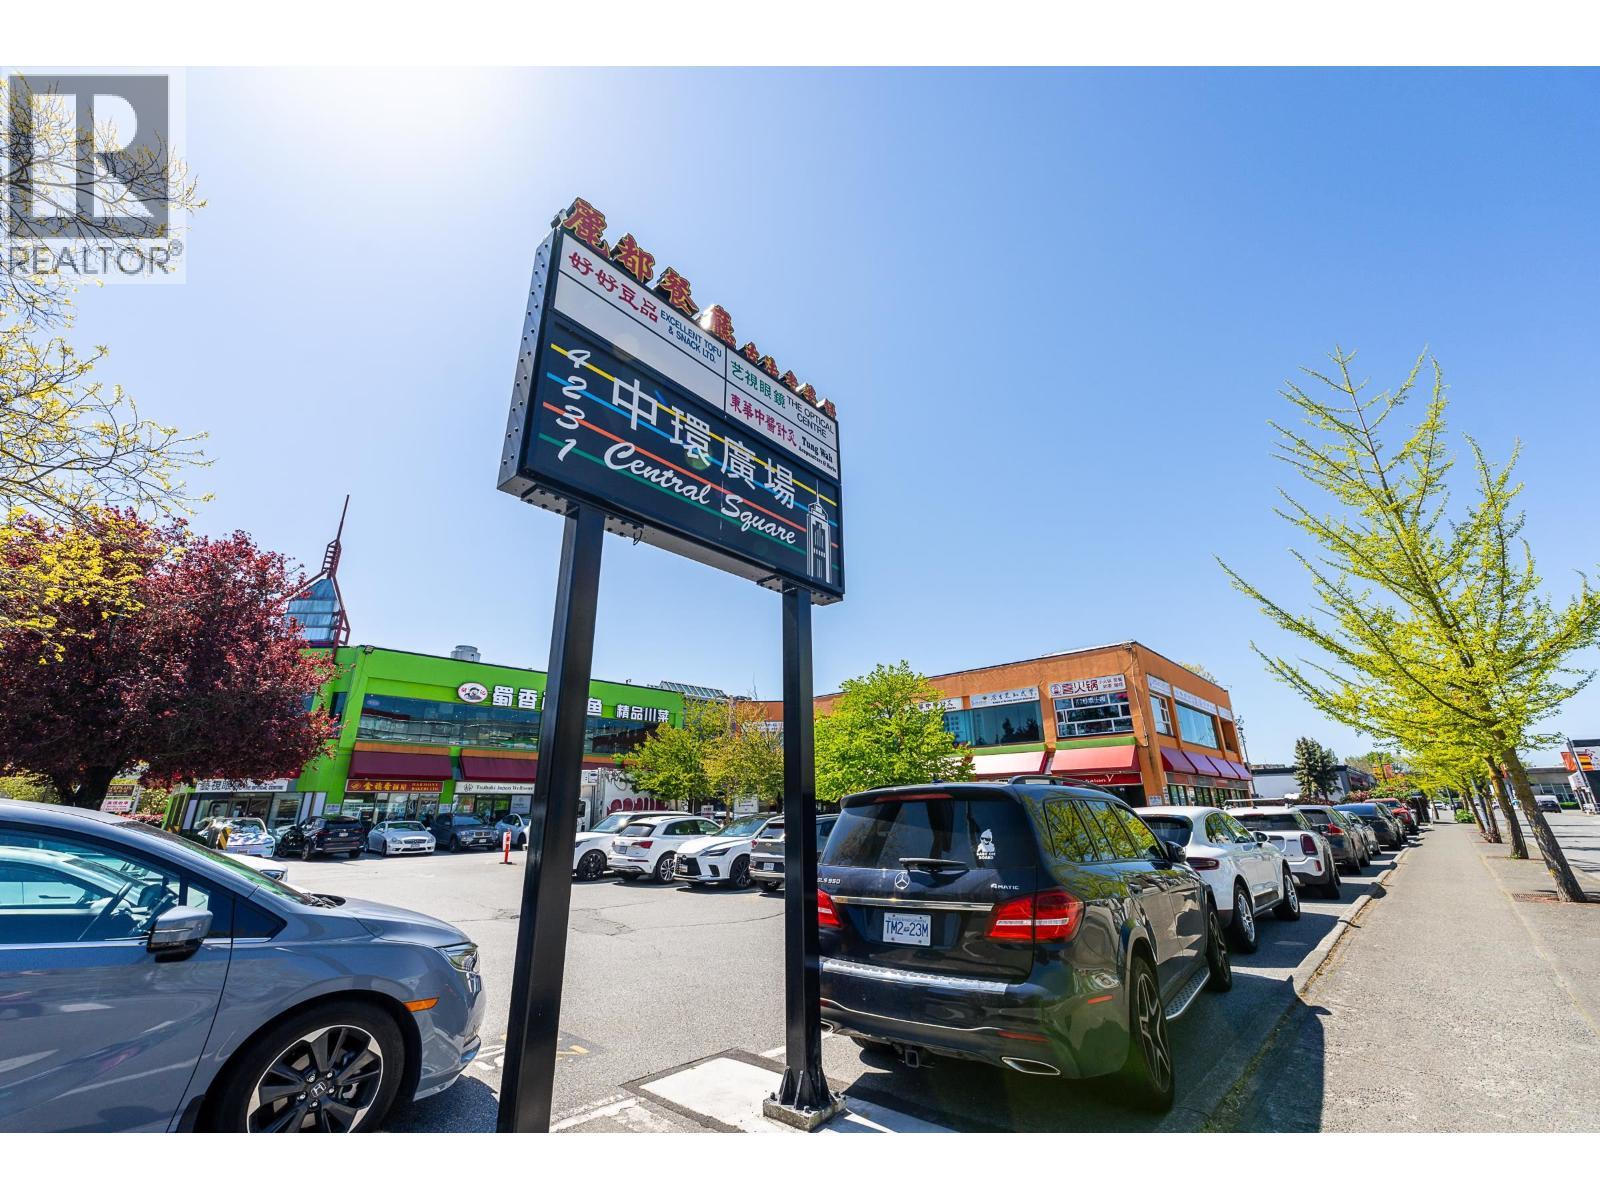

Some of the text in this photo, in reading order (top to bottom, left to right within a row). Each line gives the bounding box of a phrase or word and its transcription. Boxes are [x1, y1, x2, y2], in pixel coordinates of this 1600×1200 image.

[568, 252, 659, 323] 好好豆品
[660, 309, 702, 346] EXCELLENT
[704, 338, 723, 358] TOFU
[668, 326, 717, 364] & SNACK LTD.
[565, 348, 591, 370] 4
[562, 376, 588, 400] 2
[730, 359, 786, 409] 艺視眼鏡
[555, 404, 586, 430] 3
[786, 394, 803, 414] THE
[804, 408, 834, 435] OPTICAL
[796, 412, 827, 439] CENTRE
[556, 438, 577, 462] 1
[612, 377, 796, 510] 中環廣場
[801, 436, 833, 463] Tung Wah
[603, 441, 796, 545] Central Square
[616, 703, 670, 723] 精品川菜
